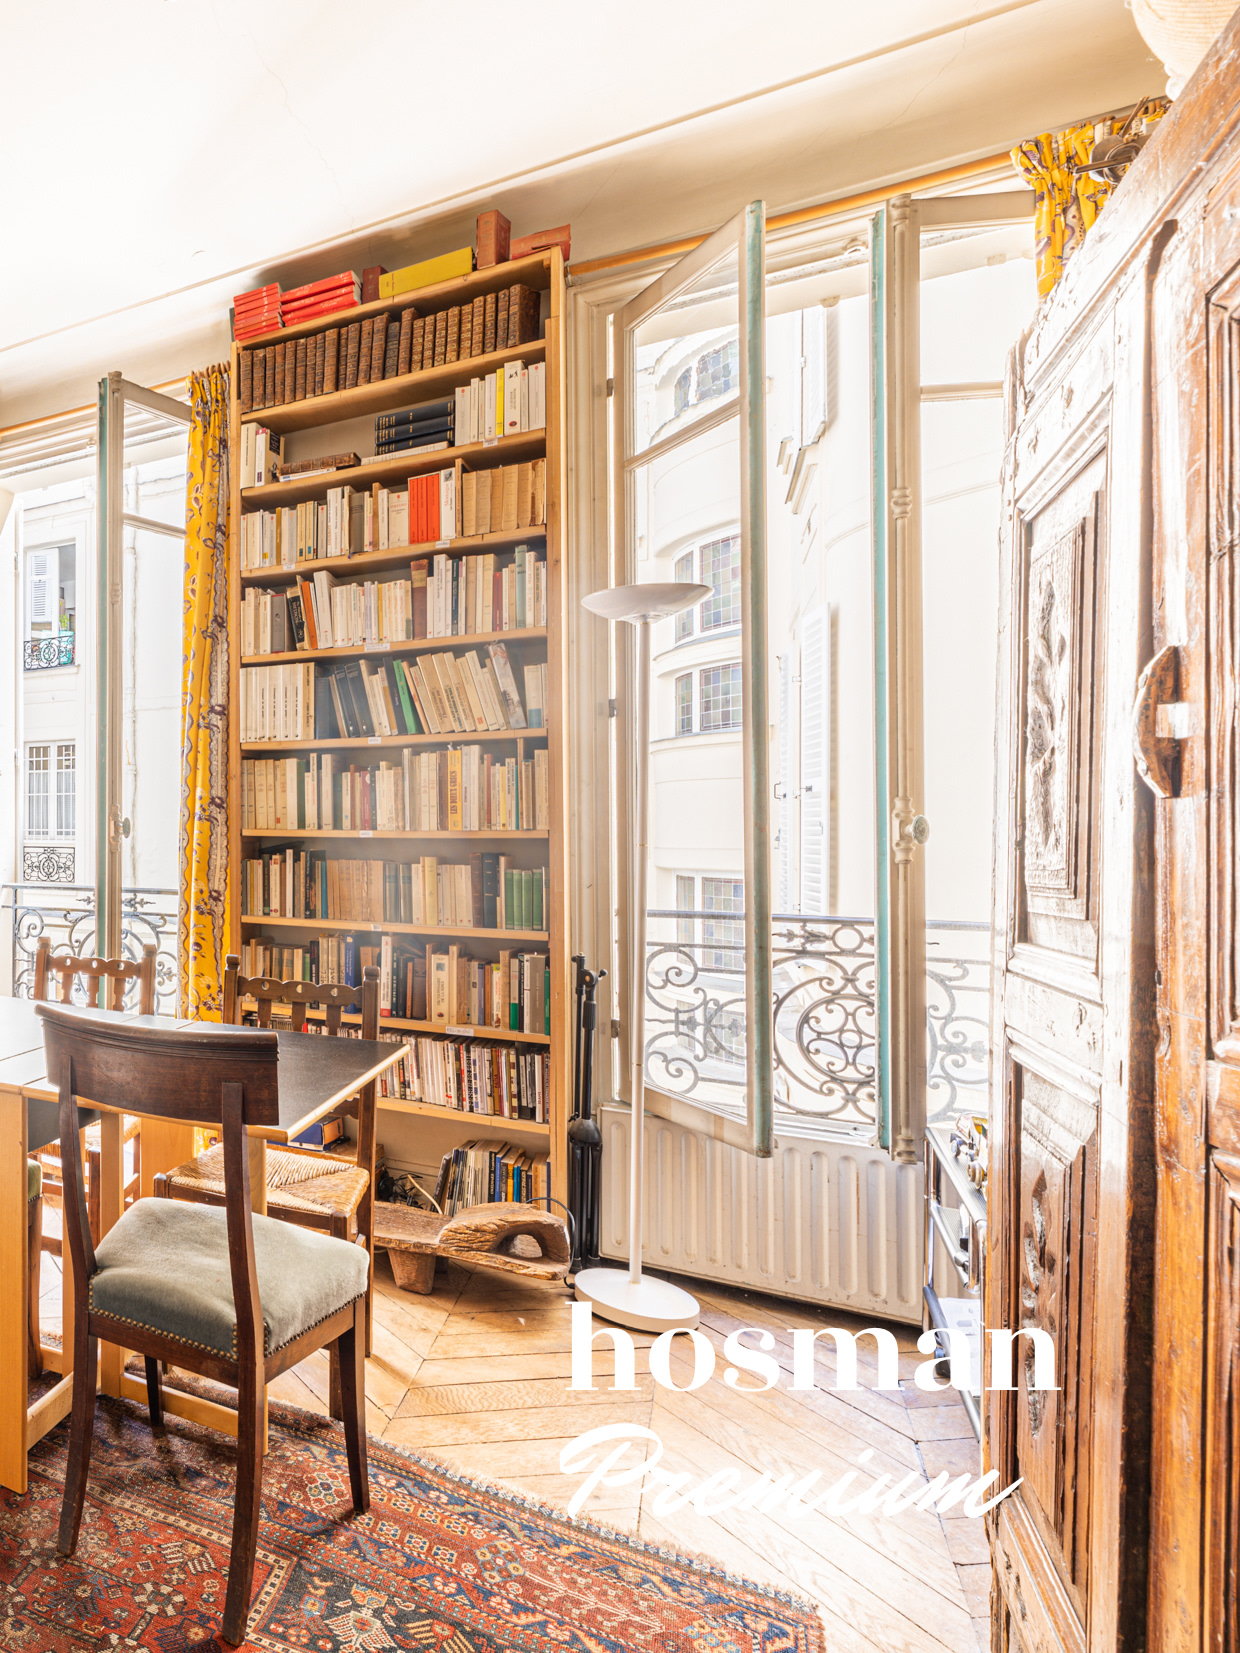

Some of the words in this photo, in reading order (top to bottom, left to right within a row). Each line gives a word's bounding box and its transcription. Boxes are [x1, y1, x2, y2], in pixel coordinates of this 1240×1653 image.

[449, 770, 457, 785] GRECS
[449, 787, 457, 803] DIEUX
[449, 804, 457, 815] LES
